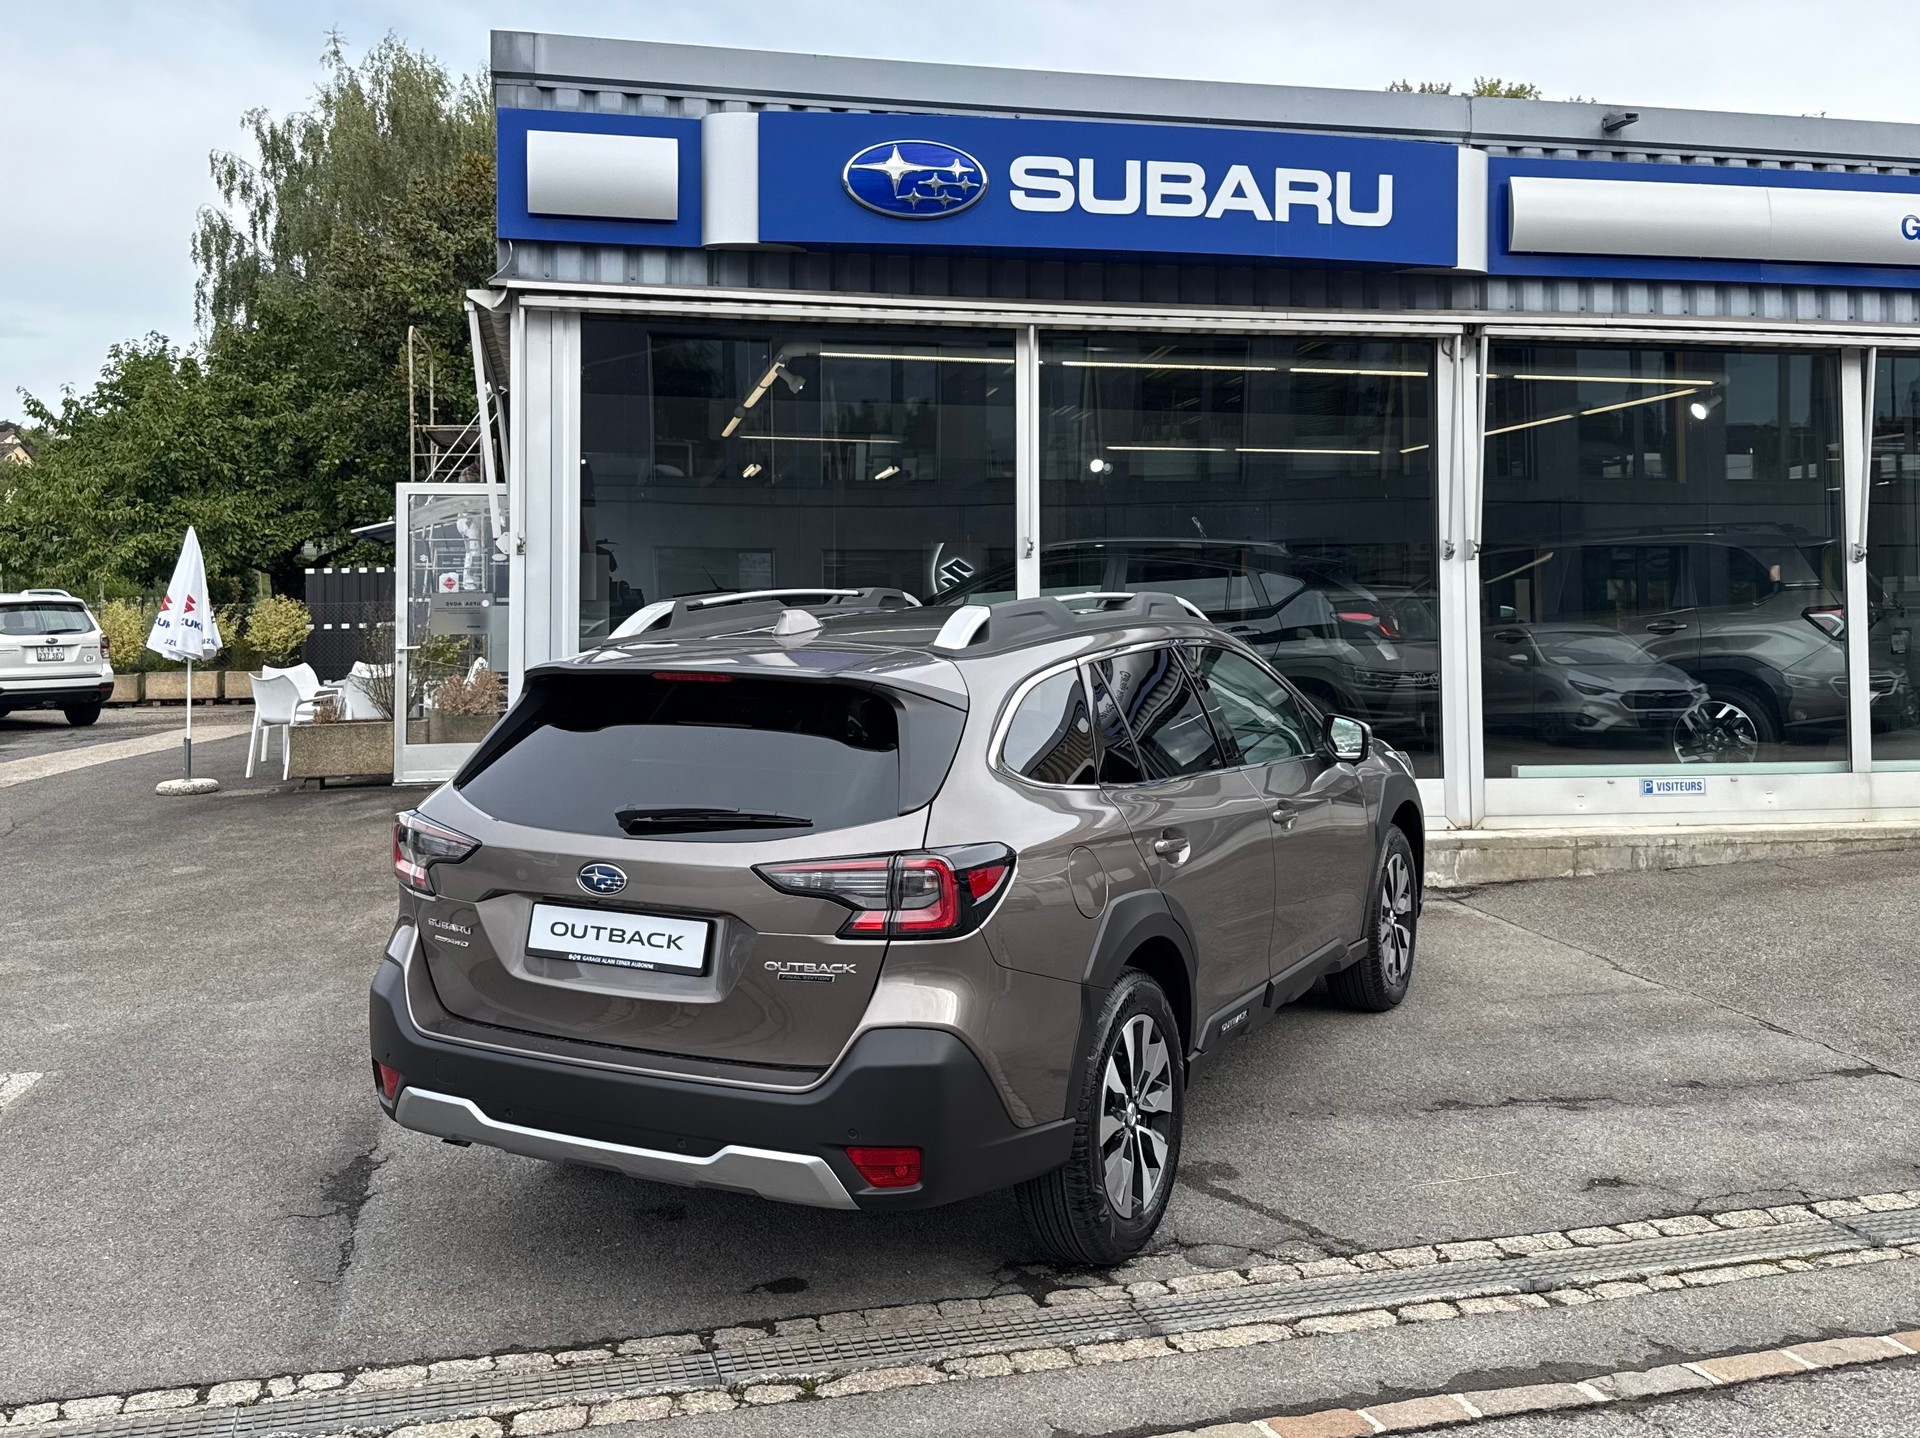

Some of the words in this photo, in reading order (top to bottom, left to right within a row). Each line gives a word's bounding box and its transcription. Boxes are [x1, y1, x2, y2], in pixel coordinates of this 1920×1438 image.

[1009, 155, 1393, 227] SUBARU
[1901, 214, 1920, 241] G
[1656, 781, 1703, 792] VISITEURS
[427, 917, 472, 935] SUBARU
[550, 921, 685, 951] OUTBACK
[763, 960, 857, 974] OUTBACK
